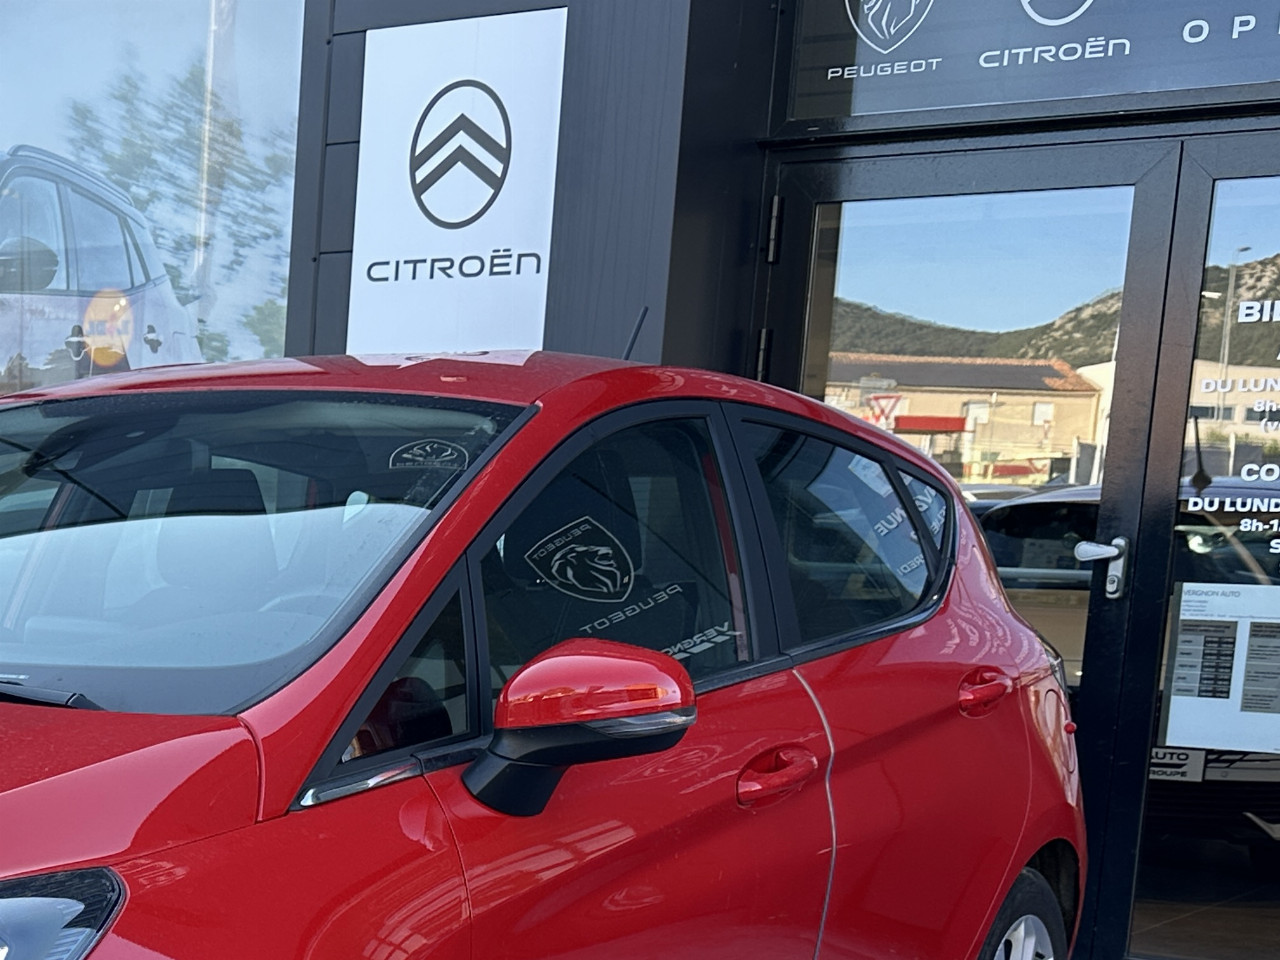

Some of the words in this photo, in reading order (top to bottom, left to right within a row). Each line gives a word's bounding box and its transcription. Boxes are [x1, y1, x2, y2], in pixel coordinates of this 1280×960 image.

[1182, 12, 1280, 44] OP
[827, 58, 943, 80] PEUGEOT
[1201, 378, 1233, 392] DU
[1187, 497, 1220, 512] DU
[1152, 751, 1189, 762] UTO
